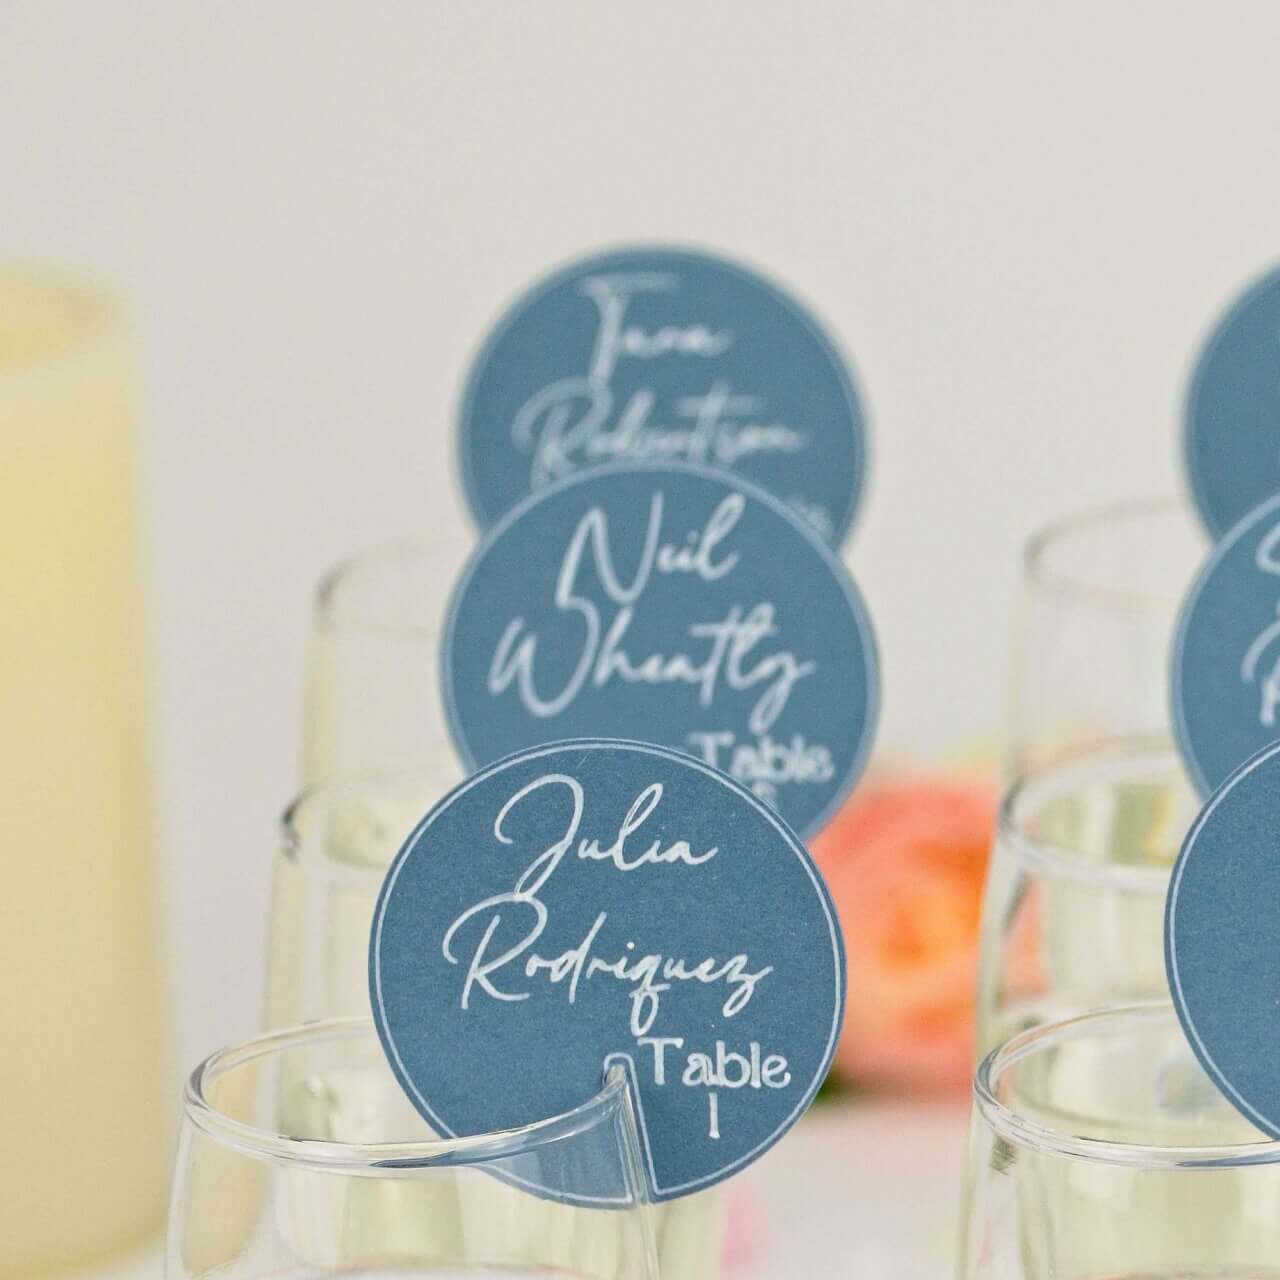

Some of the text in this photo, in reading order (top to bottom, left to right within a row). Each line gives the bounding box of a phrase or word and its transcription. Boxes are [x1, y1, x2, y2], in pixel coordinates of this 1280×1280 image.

[555, 490, 745, 609] Neil
[687, 731, 836, 782] Table
[493, 773, 719, 901] Julia
[636, 1036, 792, 1089] Table
